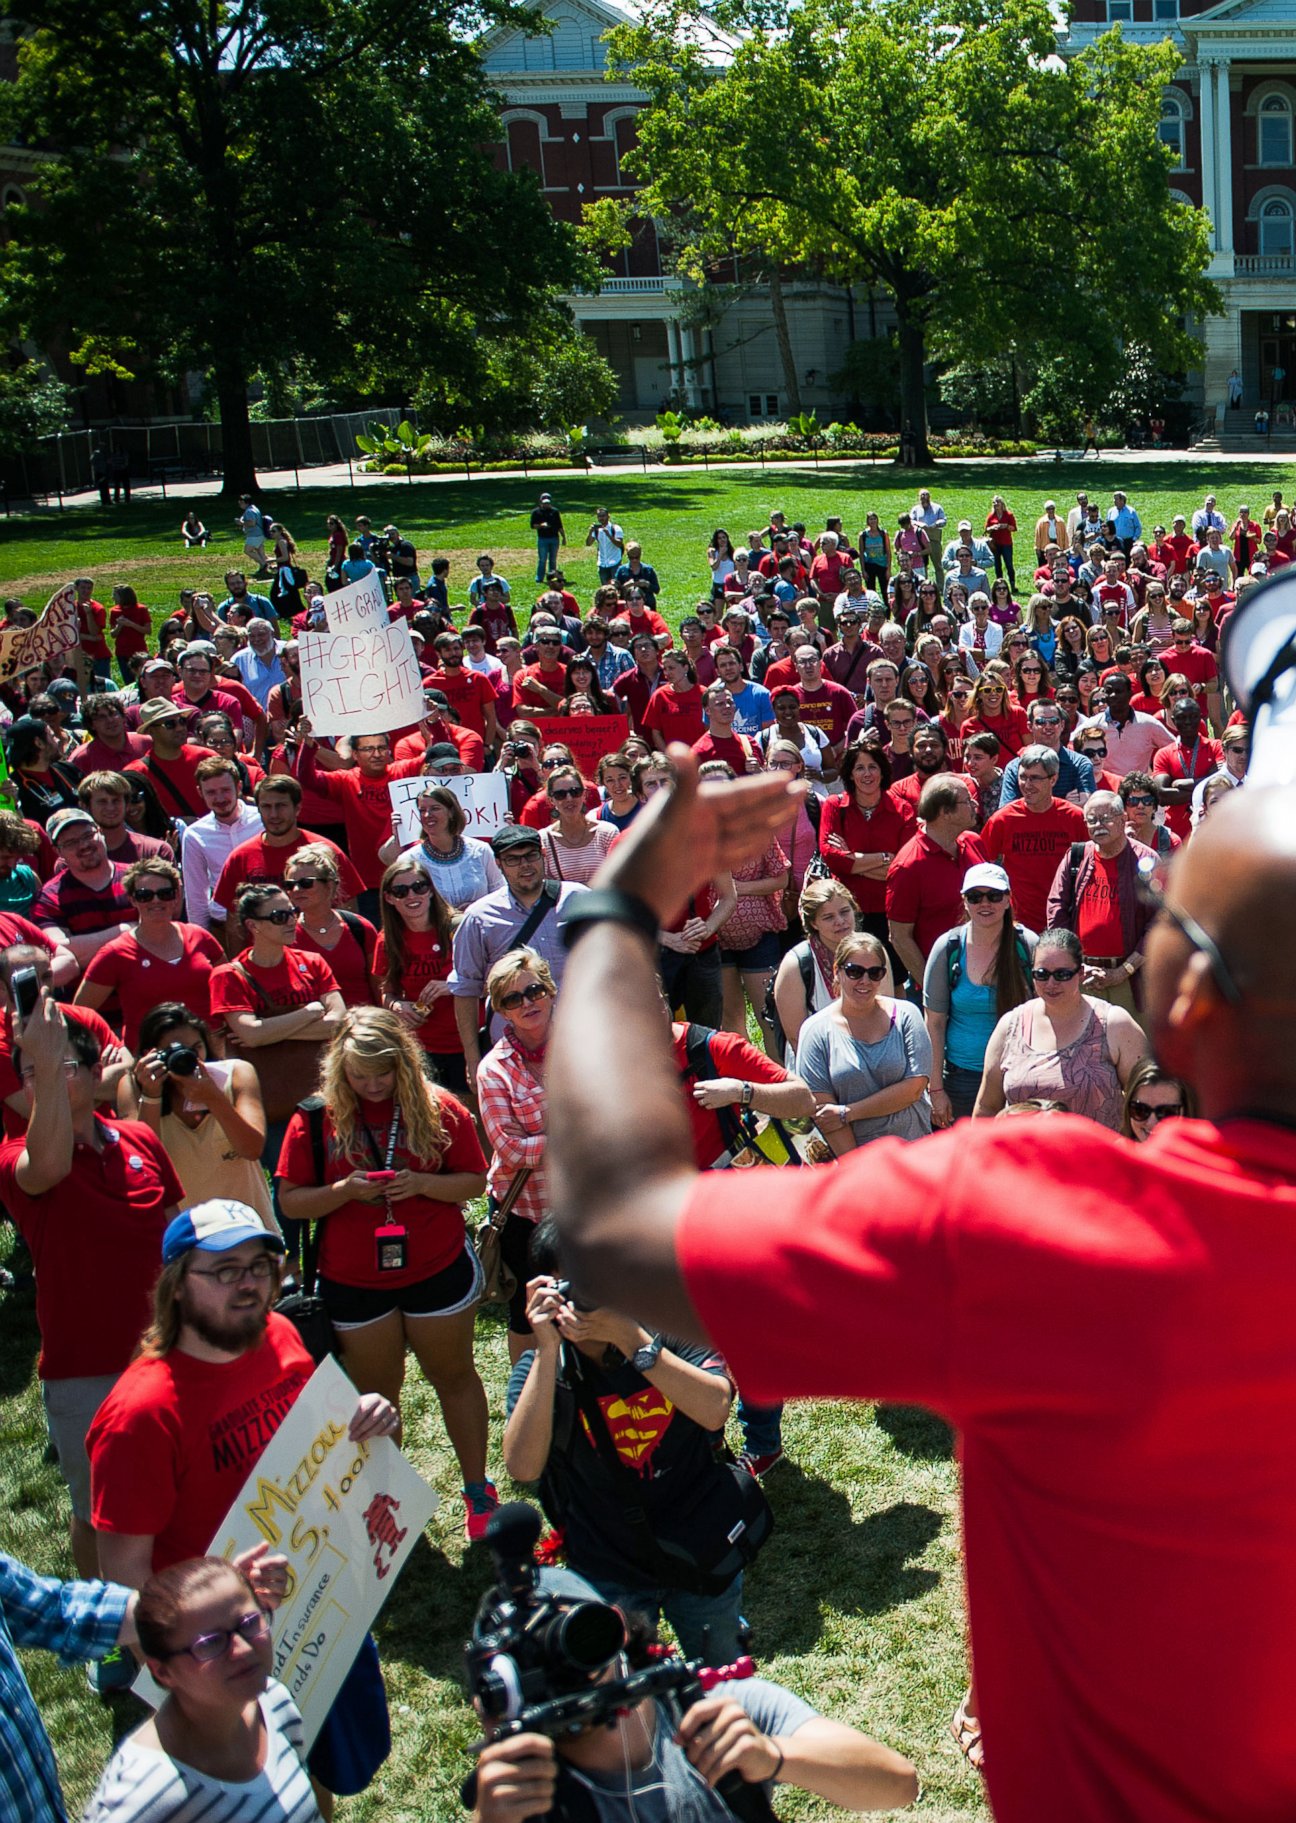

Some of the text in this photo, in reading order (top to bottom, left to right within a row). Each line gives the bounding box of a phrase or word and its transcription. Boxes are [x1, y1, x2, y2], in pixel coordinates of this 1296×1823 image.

[299, 626, 406, 671] #GRAD
[306, 653, 422, 717] RIGHTS
[245, 1419, 348, 1548] Mizzou
[279, 1572, 332, 1656] Insurance
[301, 1631, 327, 1659] Do
